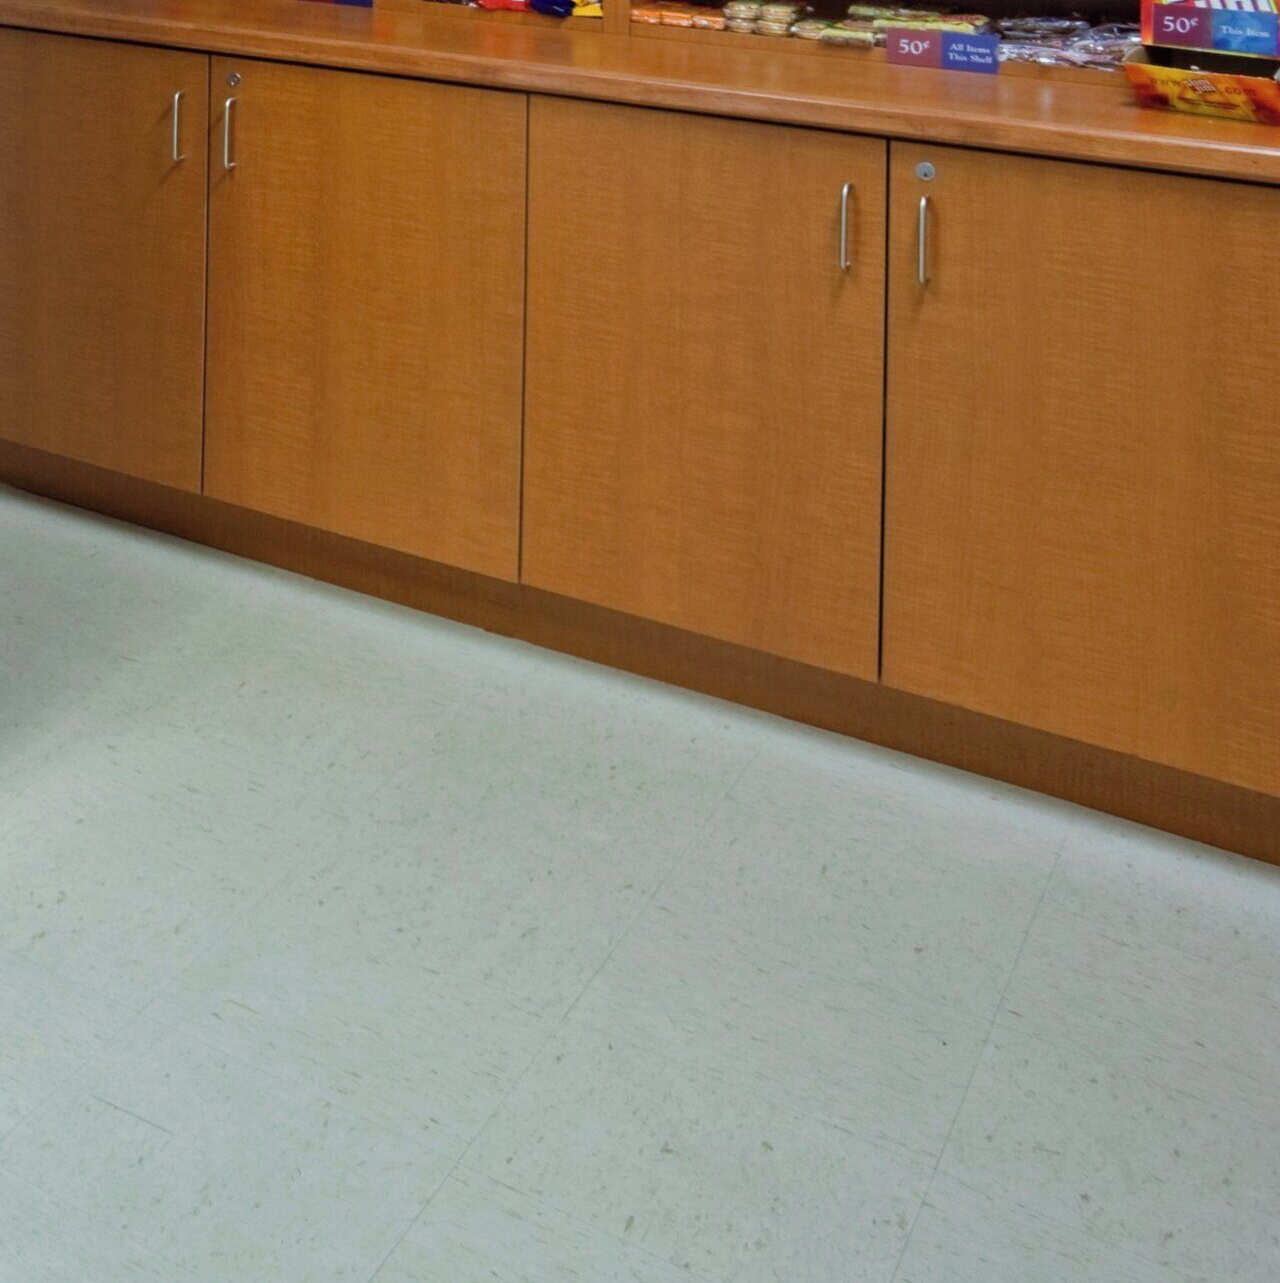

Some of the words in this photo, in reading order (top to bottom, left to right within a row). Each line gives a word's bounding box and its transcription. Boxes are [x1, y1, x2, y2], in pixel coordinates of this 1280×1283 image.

[1162, 15, 1199, 34] 50¢
[1220, 25, 1244, 36] This
[1246, 27, 1271, 38] Item
[898, 38, 931, 55] 50¢
[949, 42, 963, 52] All
[965, 43, 991, 54] Items
[947, 52, 969, 63] This
[971, 53, 993, 65] Shelf
